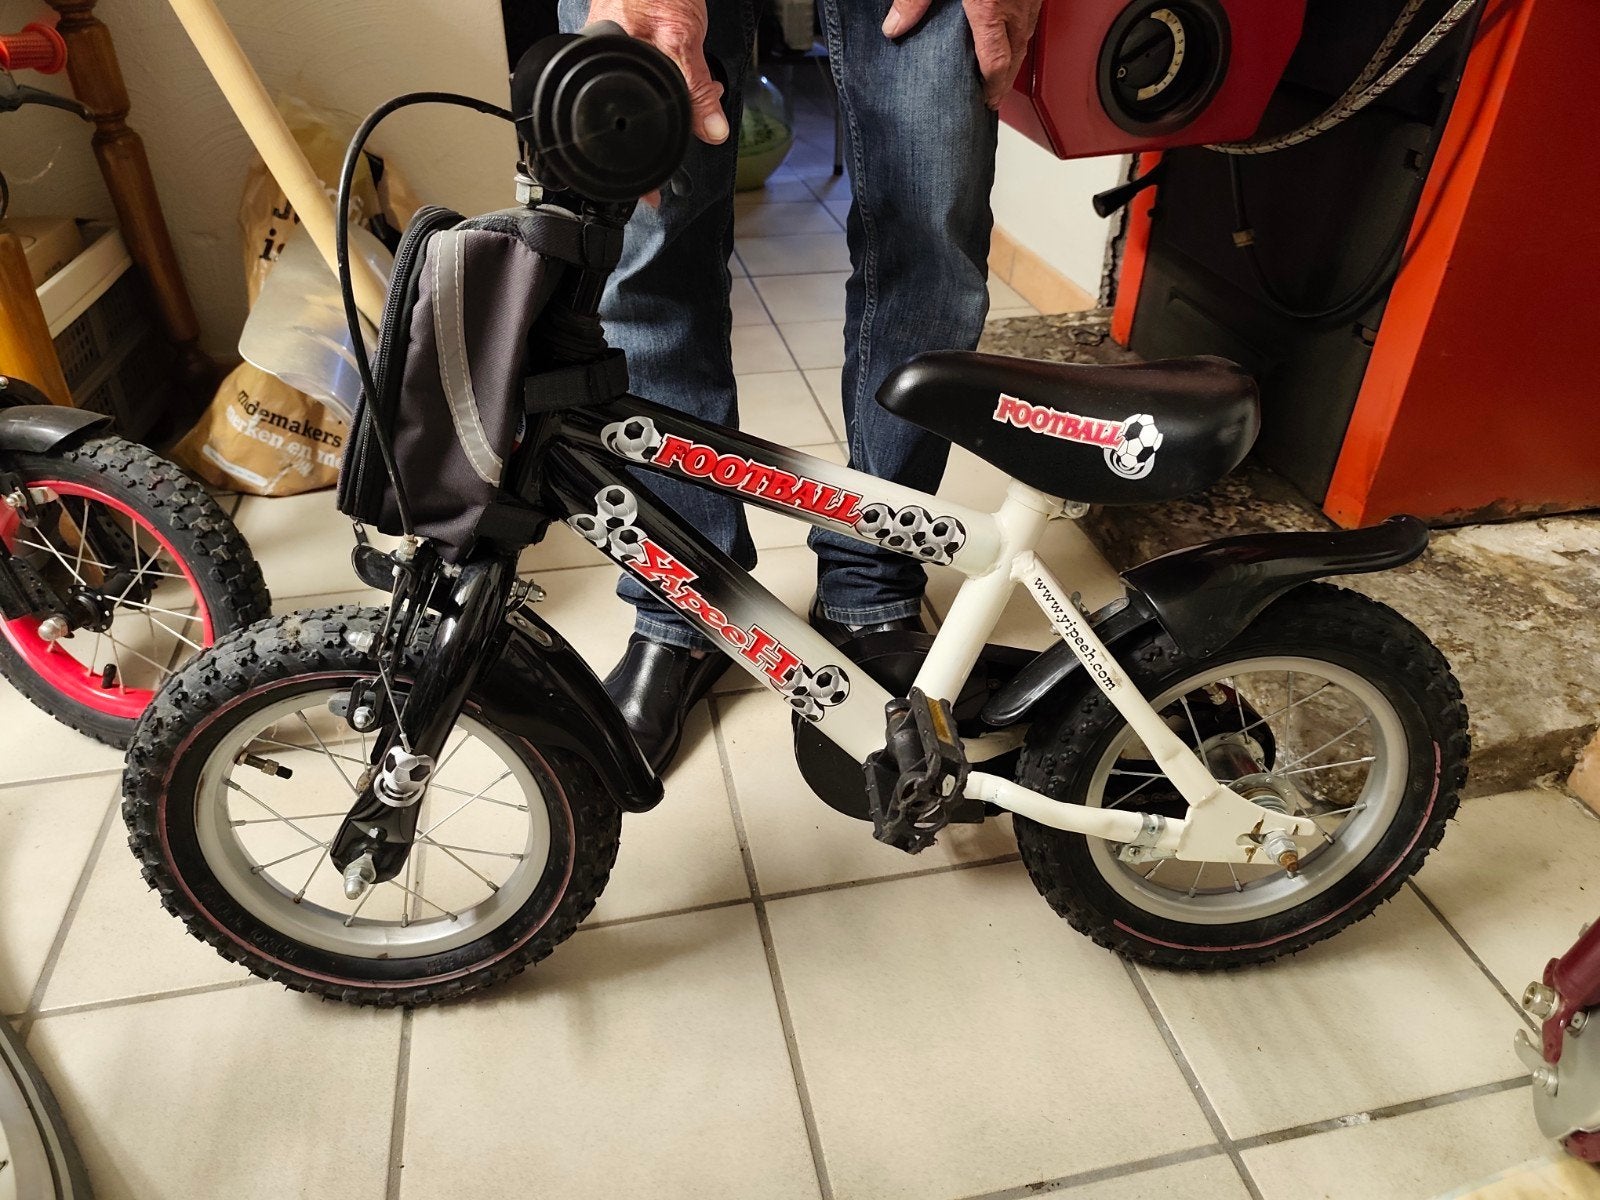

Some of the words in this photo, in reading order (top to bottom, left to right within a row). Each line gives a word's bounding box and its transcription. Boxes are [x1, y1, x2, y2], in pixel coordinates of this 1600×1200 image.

[992, 393, 1126, 450] FOOTBALL
[651, 432, 864, 527] FOOTBALL
[1034, 577, 1116, 691] www.yipeeh.com
